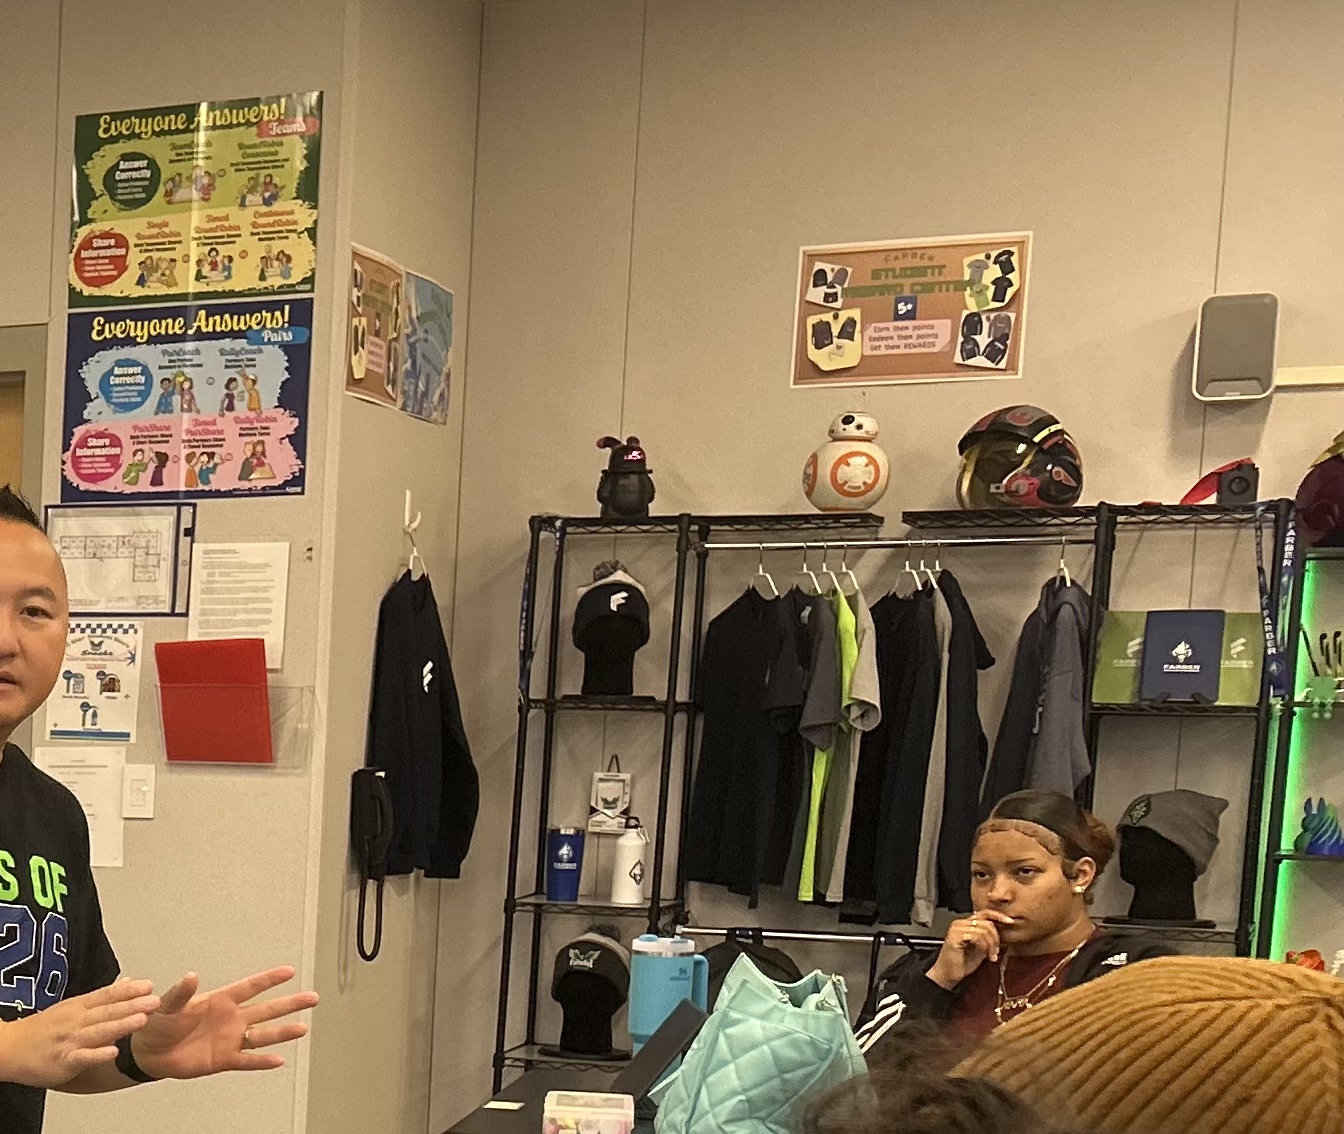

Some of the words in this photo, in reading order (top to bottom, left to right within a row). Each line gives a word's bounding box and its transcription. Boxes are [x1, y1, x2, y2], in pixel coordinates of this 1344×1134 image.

[98, 113, 188, 139] Everyone
[268, 121, 307, 136] Teams
[92, 238, 115, 248] Share
[91, 316, 185, 342] Everyone
[188, 305, 290, 334] Answers!
[262, 329, 293, 343] Pairs
[113, 366, 142, 375] Answer
[109, 374, 145, 385] Correctly
[87, 437, 109, 447] Share
[75, 446, 121, 457] Information
[1263, 609, 1277, 655] FARBER
[29, 855, 68, 913] OF
